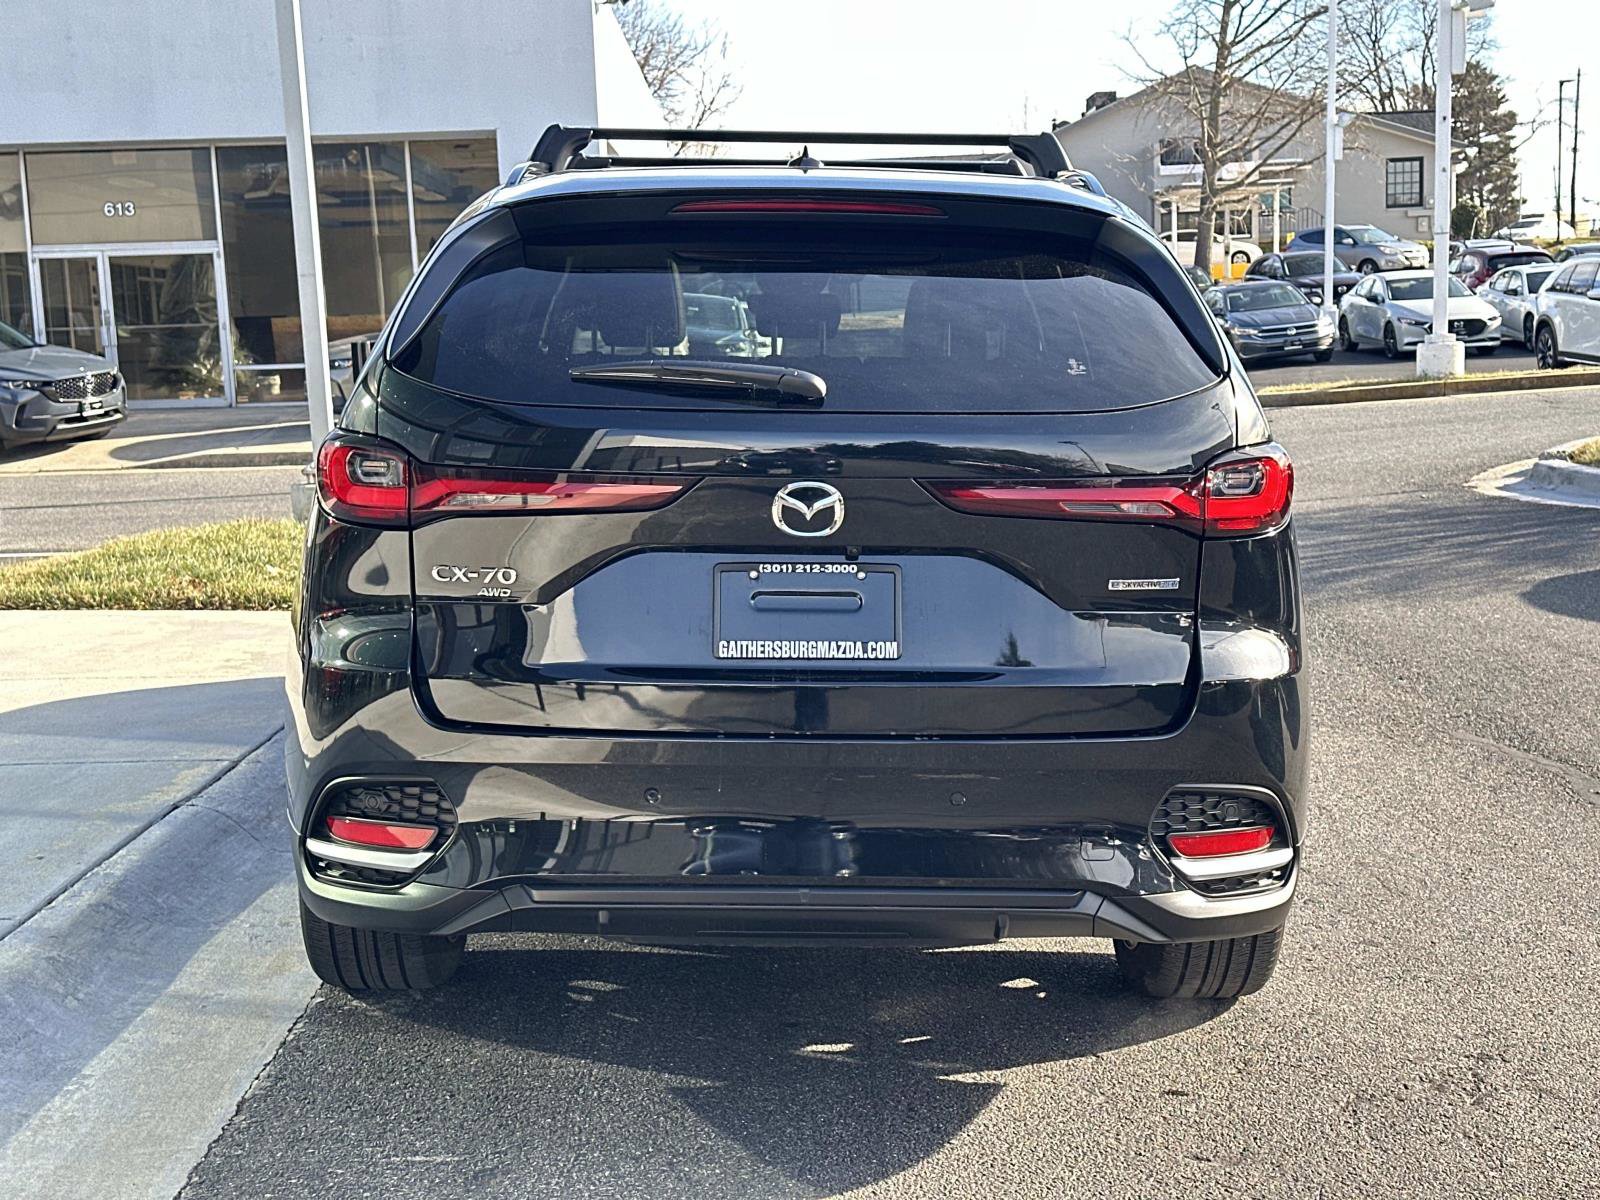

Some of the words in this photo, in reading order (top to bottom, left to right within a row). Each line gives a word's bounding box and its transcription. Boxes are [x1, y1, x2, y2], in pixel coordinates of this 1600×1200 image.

[104, 202, 135, 216] 613
[431, 565, 517, 585] CX-70
[759, 564, 792, 573] (301)
[795, 565, 858, 573] 212-3000
[478, 587, 511, 597] AWD
[718, 640, 898, 659] GAITHERSBURGMAZDA.COM
